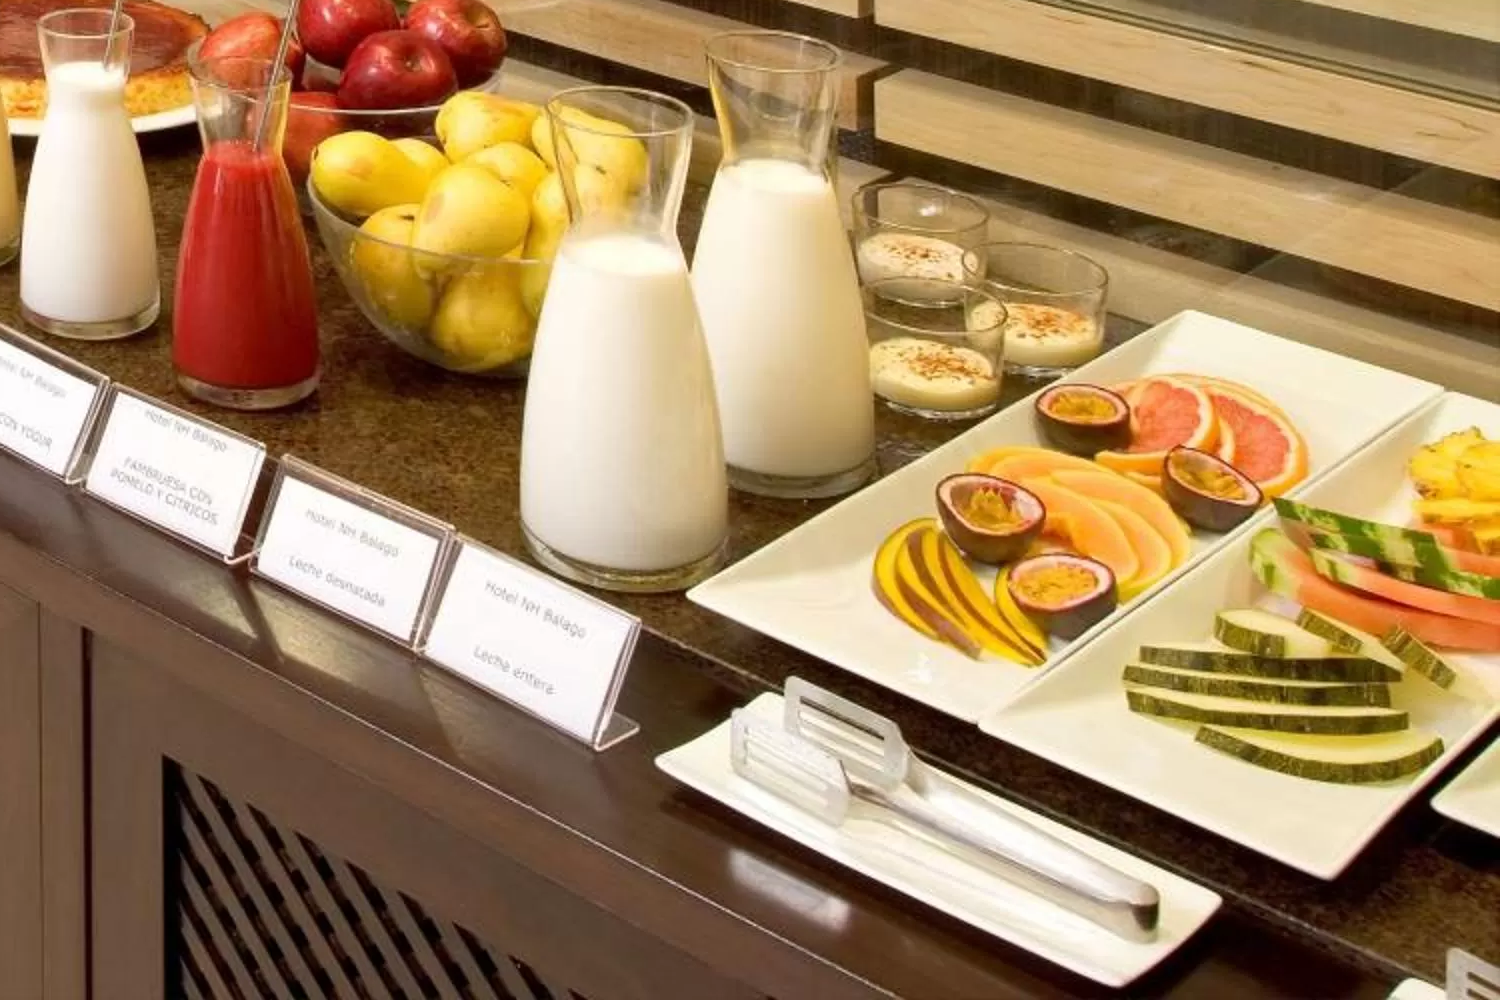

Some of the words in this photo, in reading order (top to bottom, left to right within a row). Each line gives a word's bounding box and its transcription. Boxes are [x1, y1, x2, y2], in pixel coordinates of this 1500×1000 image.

[19, 422, 53, 451] YOGUR
[144, 408, 172, 430] Hotel
[173, 419, 190, 437] NH
[110, 467, 155, 496] POMELO
[188, 485, 214, 506] CON
[304, 507, 336, 531] Hotel
[337, 520, 358, 538] NH
[358, 530, 400, 559] Balago
[288, 554, 324, 580] Leche
[324, 571, 386, 609] desnatada
[484, 579, 519, 606] Hotel
[520, 595, 542, 617] NH
[542, 607, 587, 640] Balago
[472, 645, 511, 674] Leche
[512, 666, 556, 697] entera
